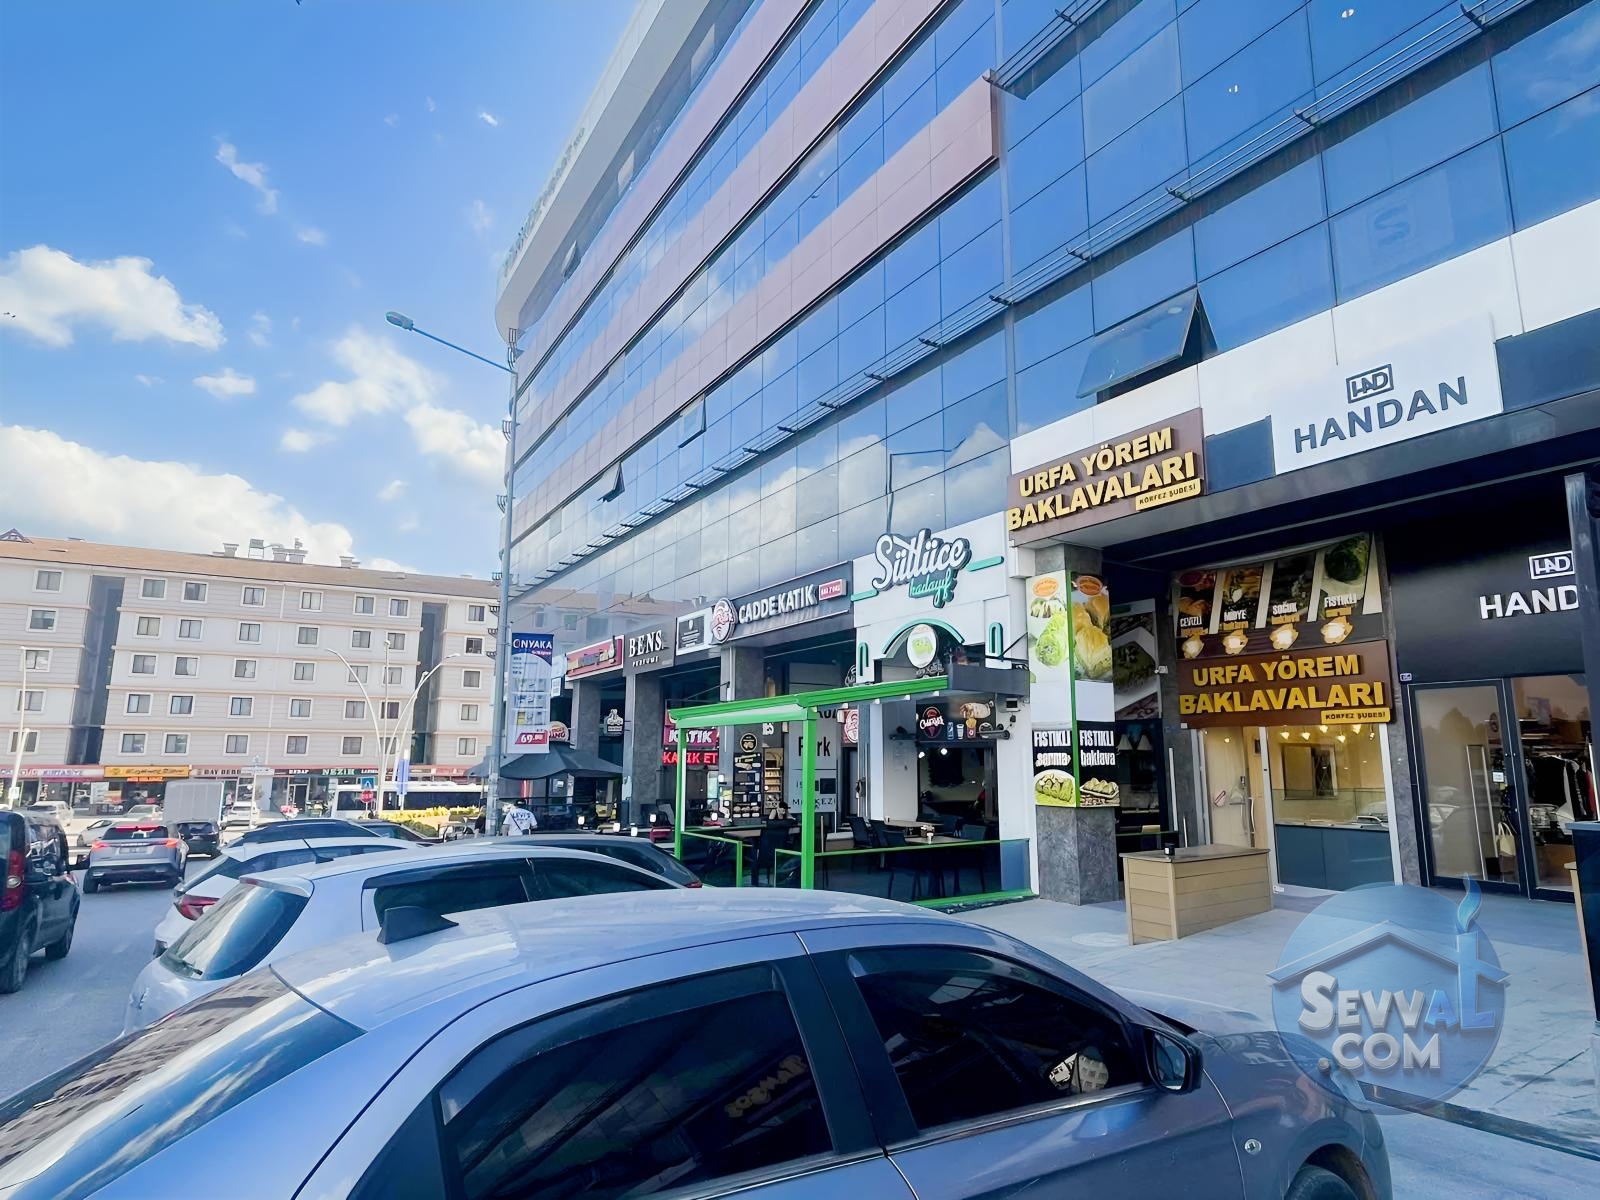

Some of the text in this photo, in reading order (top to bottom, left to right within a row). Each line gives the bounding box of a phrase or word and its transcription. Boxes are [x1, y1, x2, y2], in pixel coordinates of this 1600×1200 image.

[1294, 376, 1468, 454] HANDAN
[1019, 427, 1173, 497] URFA YÖREM
[1008, 452, 1196, 531] BAKLAVALARI
[872, 528, 969, 591] Sütlüce
[739, 595, 779, 624] CADDE
[778, 584, 817, 614] KATIK
[1193, 654, 1360, 686] URFA YÖREM
[1179, 681, 1385, 715] BAKLAVALARI
[1034, 730, 1071, 747] FISTIKLI
[1079, 730, 1115, 747] FISTIKLI
[704, 752, 718, 764] ET
[1081, 749, 1116, 766] baklava
